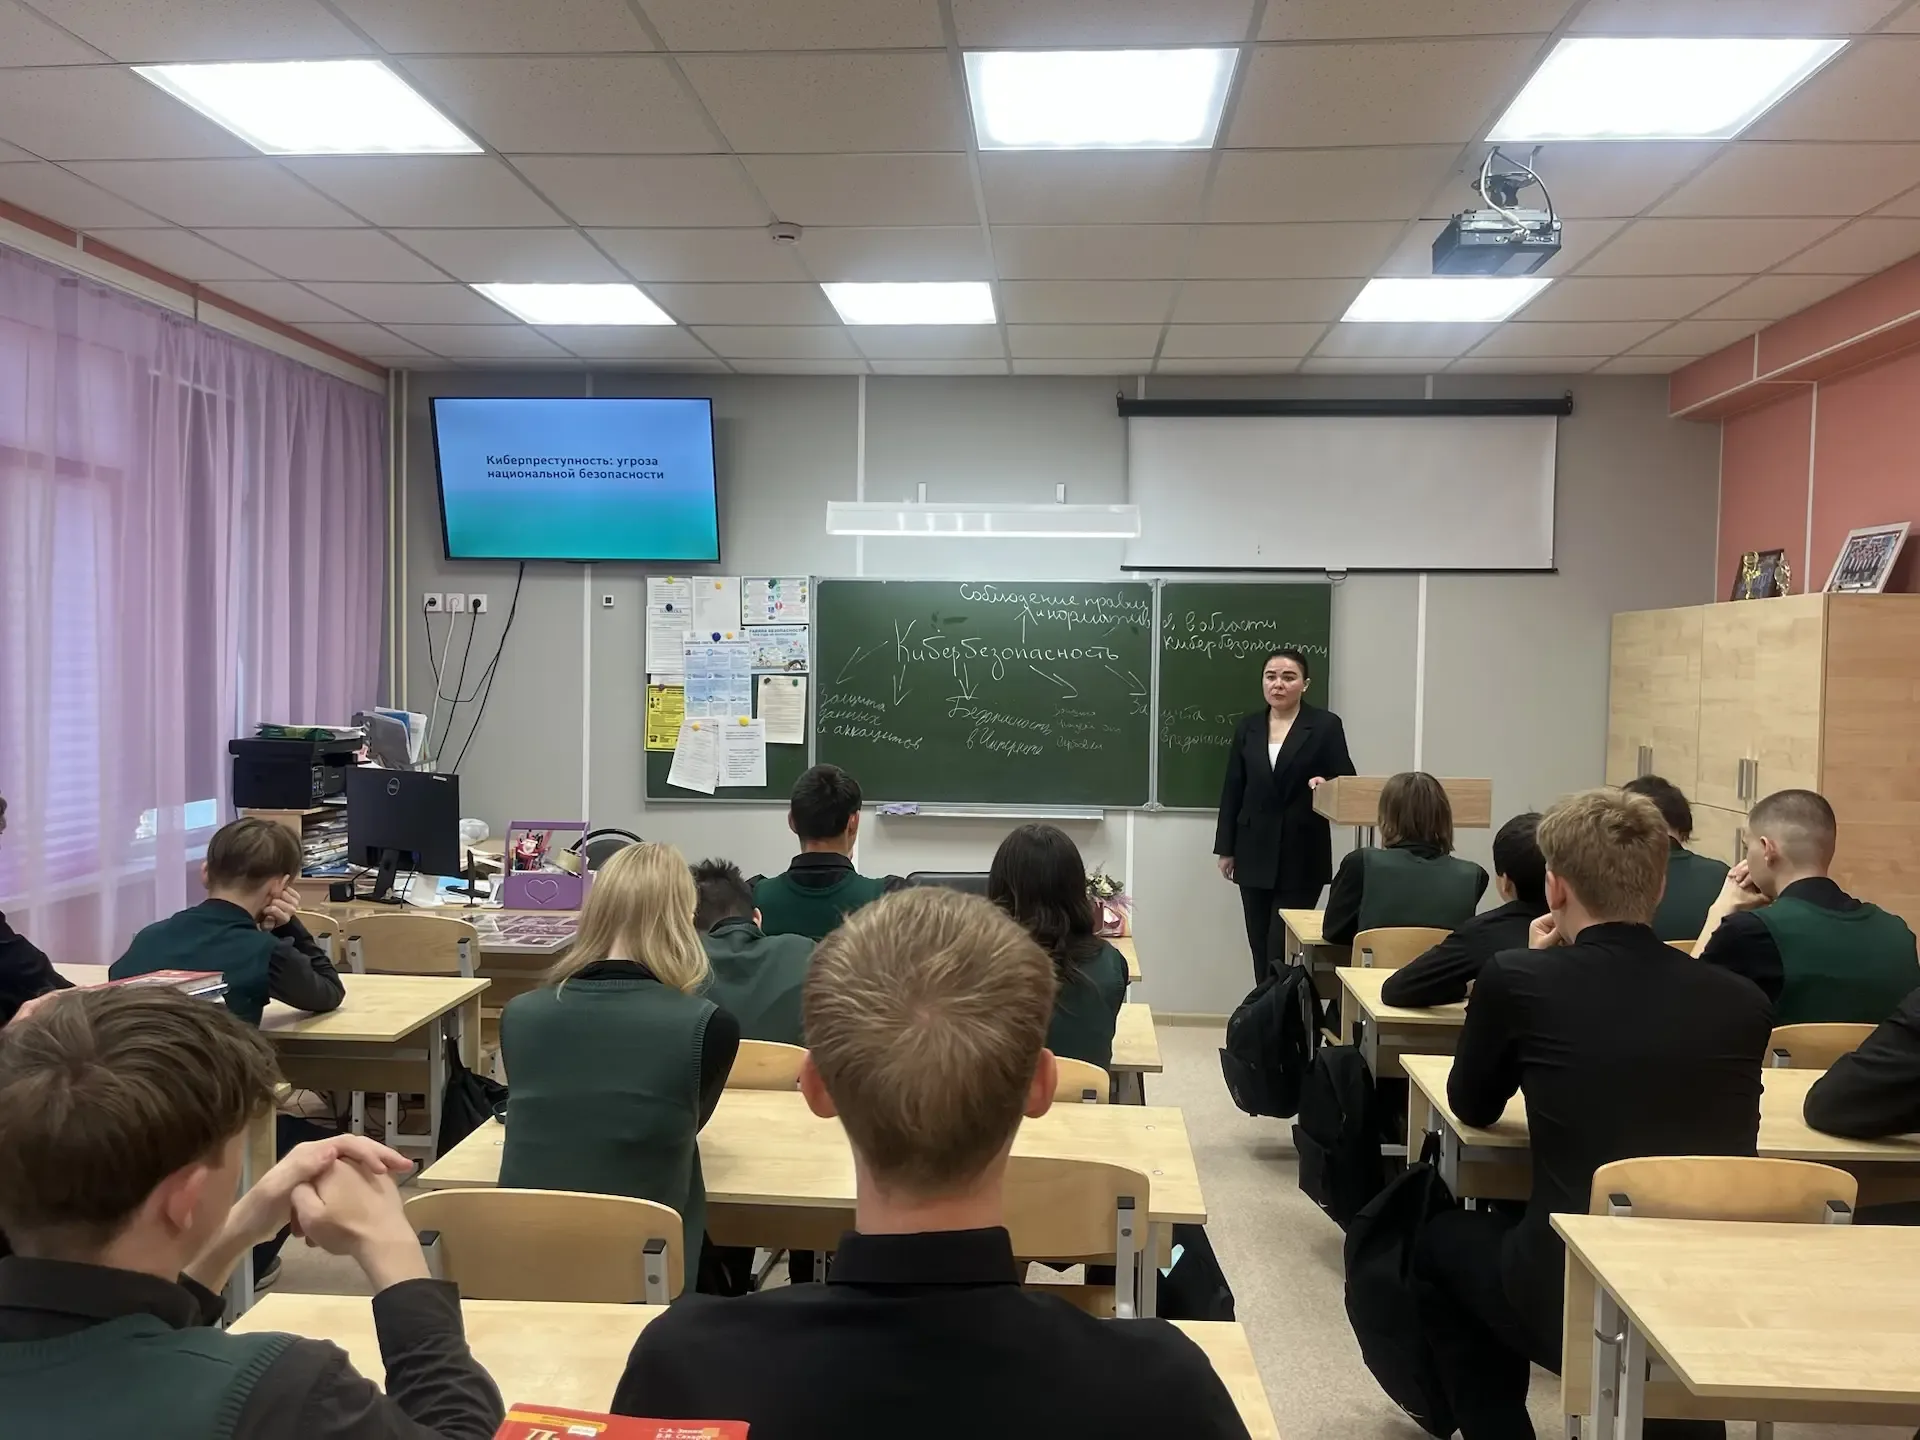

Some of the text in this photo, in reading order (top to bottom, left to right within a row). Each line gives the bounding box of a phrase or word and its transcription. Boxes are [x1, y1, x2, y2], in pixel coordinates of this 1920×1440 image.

[486, 455, 658, 468] Киберпреступность: угроза
[487, 468, 664, 479] национальной безопасности
[959, 583, 1080, 606] Соблюдение
[1199, 611, 1277, 633] области
[894, 618, 1119, 681] Кибербезопасность
[816, 726, 827, 734] и
